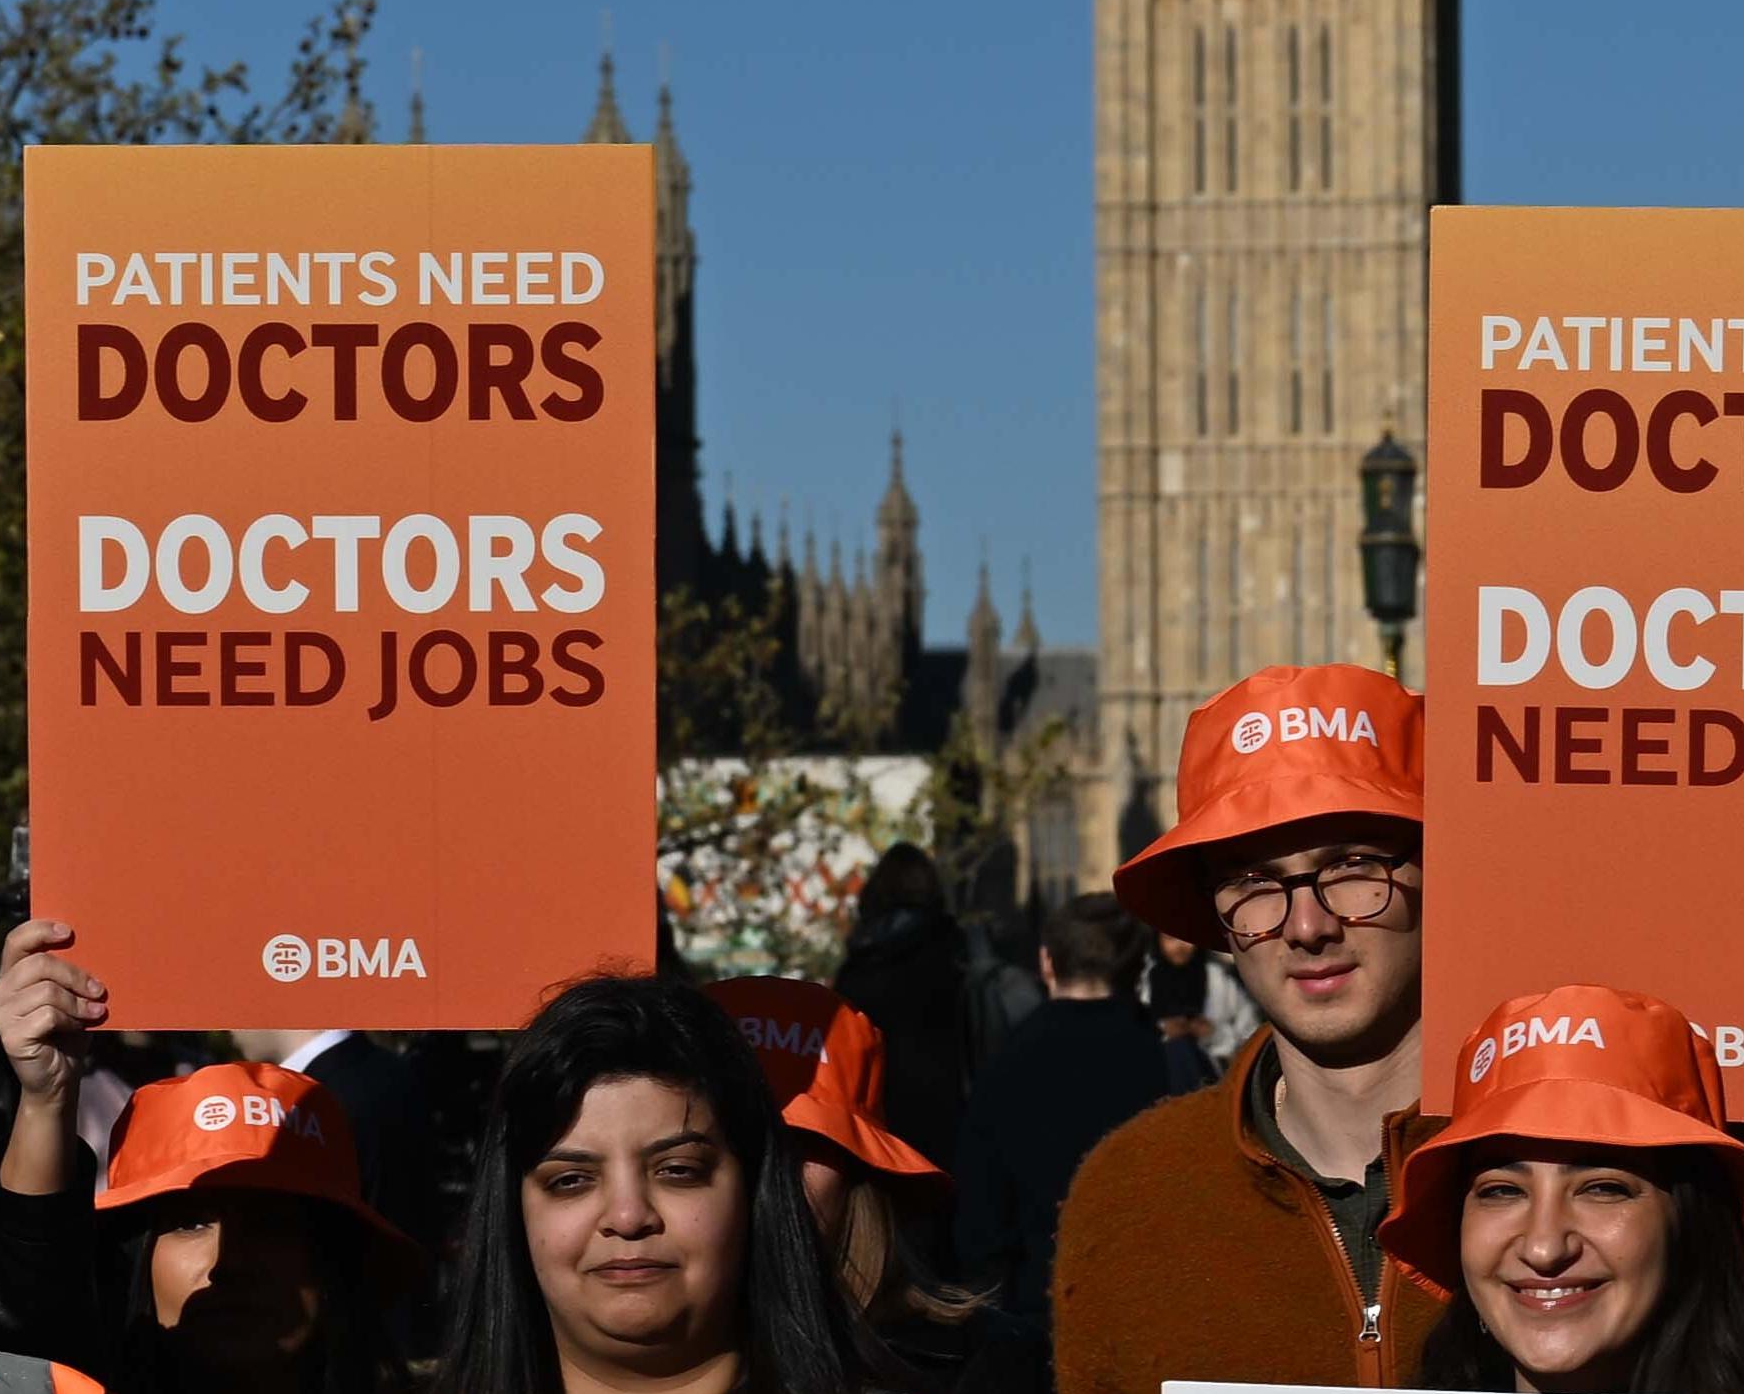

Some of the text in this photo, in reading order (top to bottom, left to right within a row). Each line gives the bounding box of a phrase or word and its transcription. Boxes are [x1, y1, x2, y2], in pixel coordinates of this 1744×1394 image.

[75, 251, 604, 307] PATIENTS NEED
[76, 321, 605, 424] DOCTORS
[79, 513, 606, 615] DOCTORS
[80, 629, 606, 722] NEED JOBS
[1279, 707, 1379, 748] BMA
[317, 937, 427, 979] BMA
[739, 1017, 828, 1064] BMA
[1501, 1016, 1605, 1059] BMA
[242, 1095, 326, 1145] BMA
